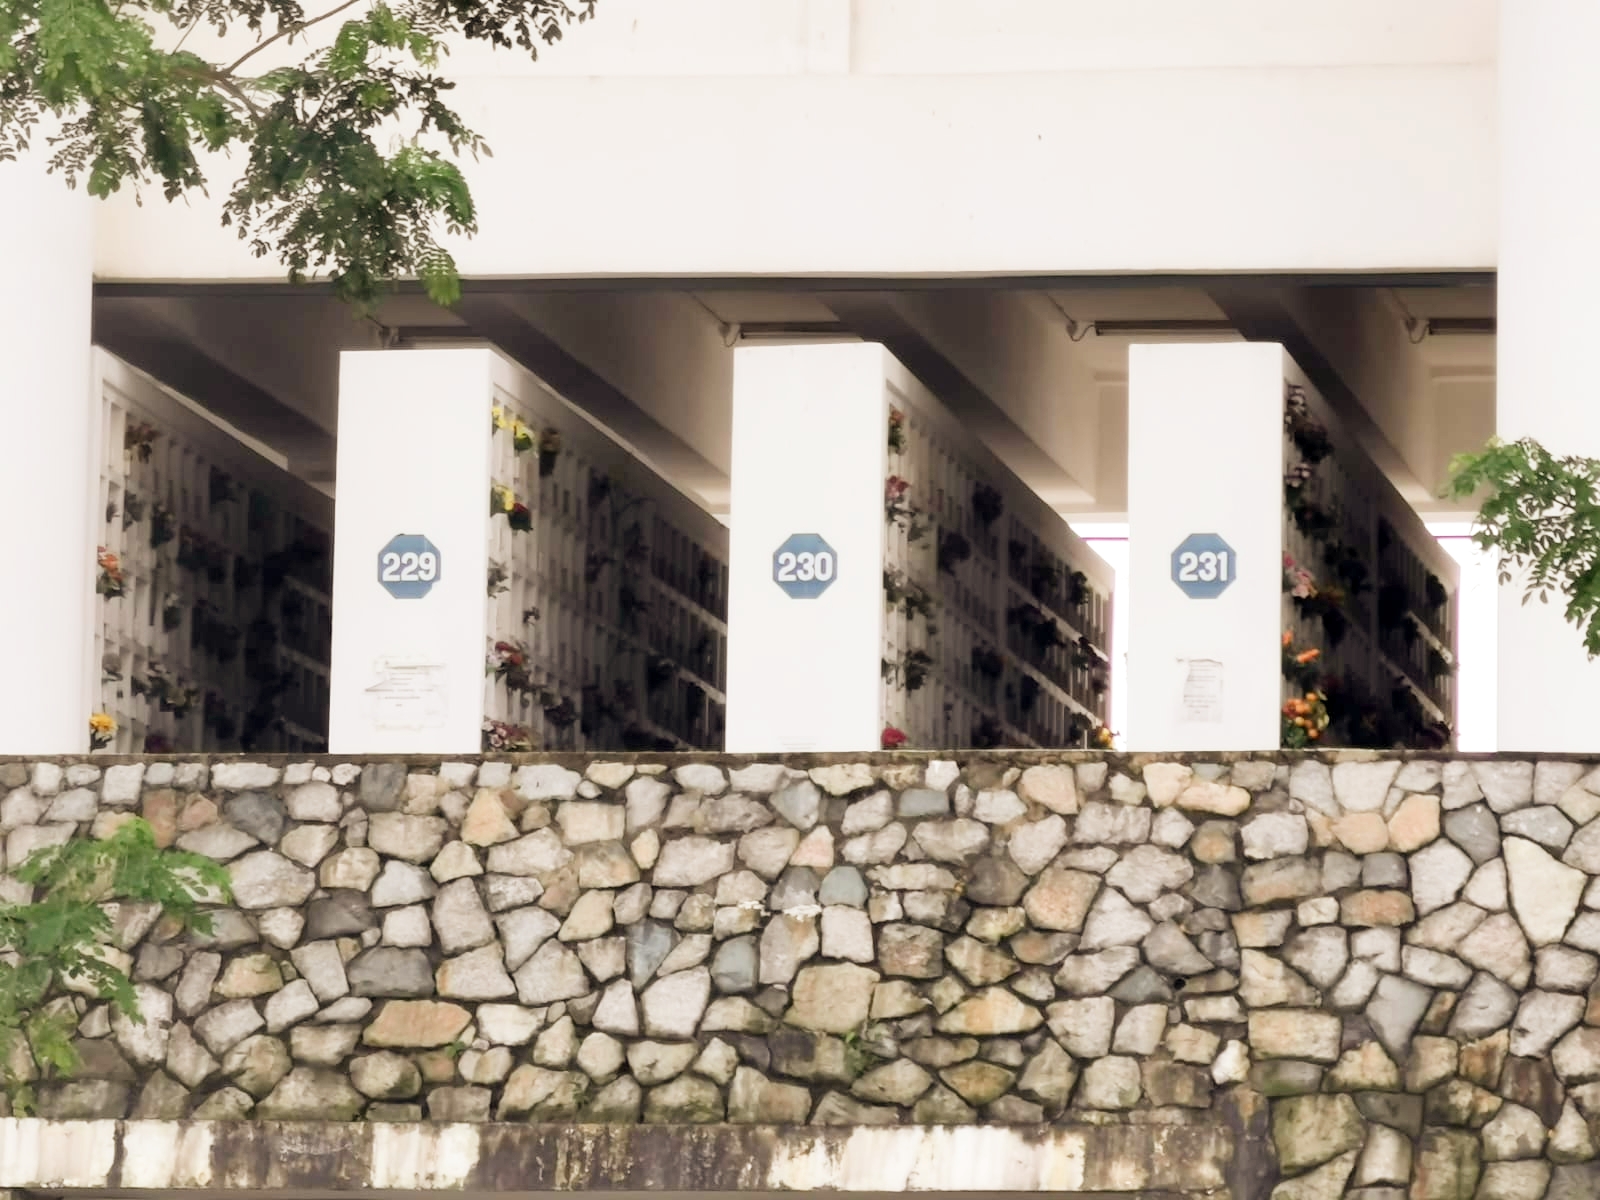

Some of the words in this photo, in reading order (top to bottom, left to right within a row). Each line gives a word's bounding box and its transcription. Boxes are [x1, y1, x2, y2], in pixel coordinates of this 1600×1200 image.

[382, 551, 437, 582] 229
[778, 551, 833, 582] 230
[1179, 551, 1228, 582] 231
